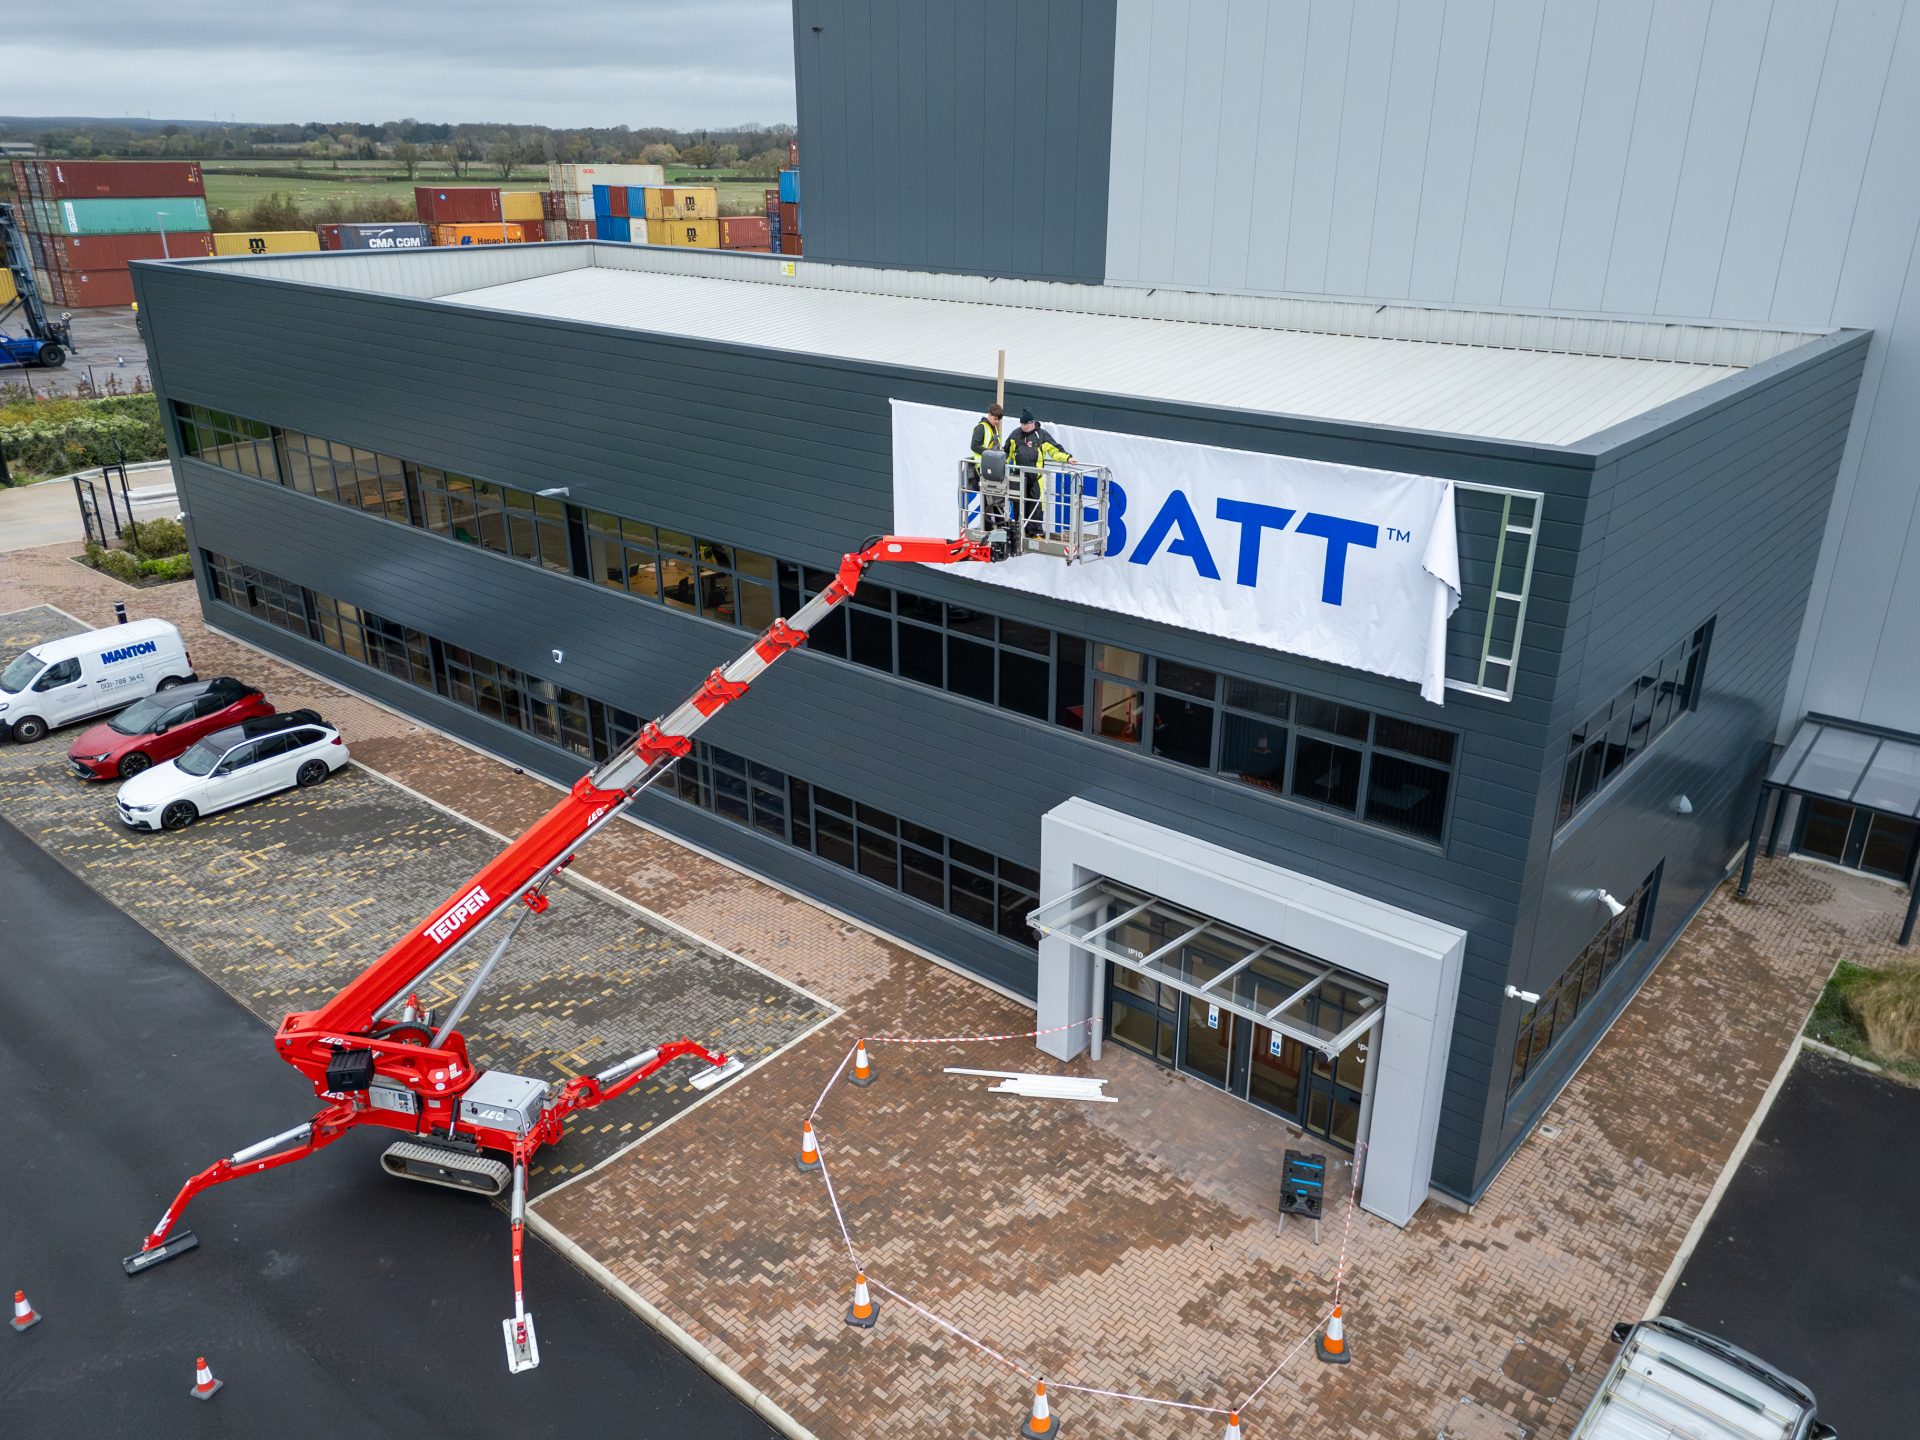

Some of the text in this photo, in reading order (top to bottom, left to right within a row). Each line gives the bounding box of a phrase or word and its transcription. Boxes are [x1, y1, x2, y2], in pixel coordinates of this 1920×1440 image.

[368, 237, 420, 248] CMA CGM
[100, 640, 157, 665] MANTON
[423, 885, 491, 944] TEUPEN
[478, 1109, 505, 1122] LEO
